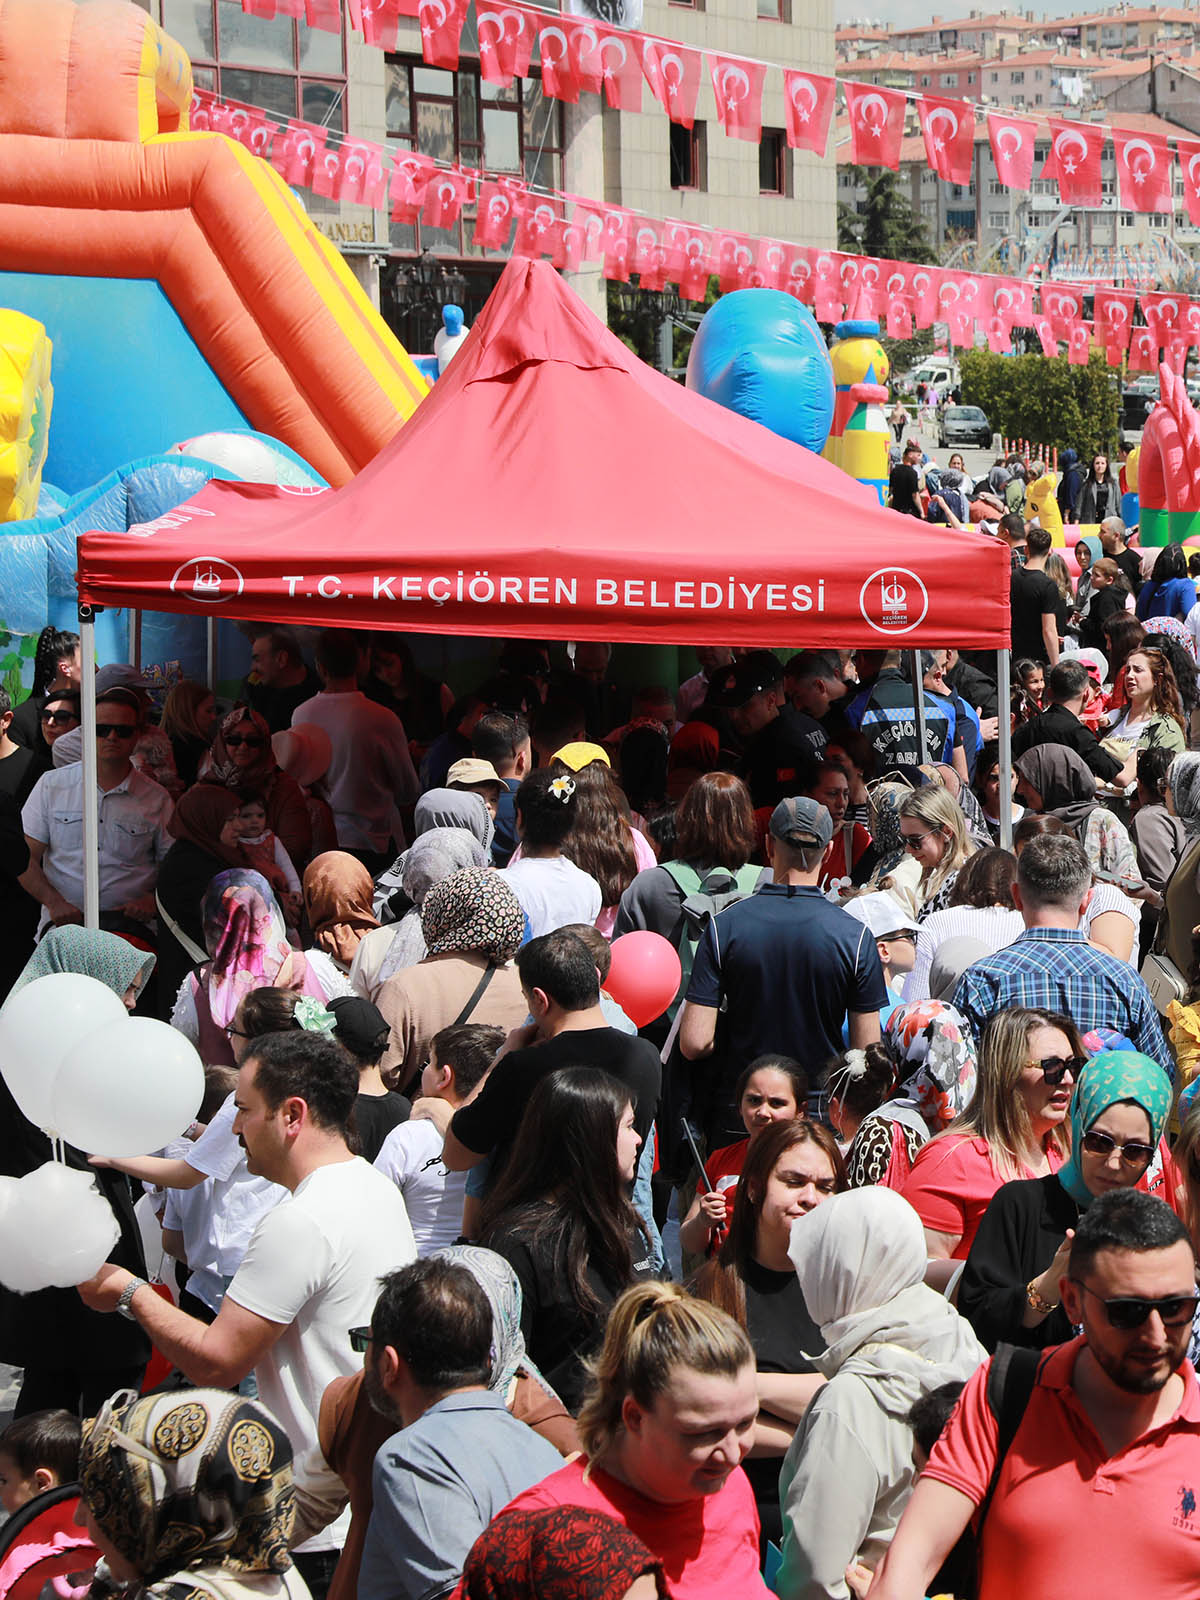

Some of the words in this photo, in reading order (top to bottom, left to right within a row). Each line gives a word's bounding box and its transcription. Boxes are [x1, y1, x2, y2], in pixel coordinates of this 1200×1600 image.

[282, 575, 354, 599] T.C.
[373, 571, 577, 606] KEÇİÖREN
[596, 576, 825, 612] BELEDİYESİ
[873, 721, 942, 753] KEÇİÖEN
